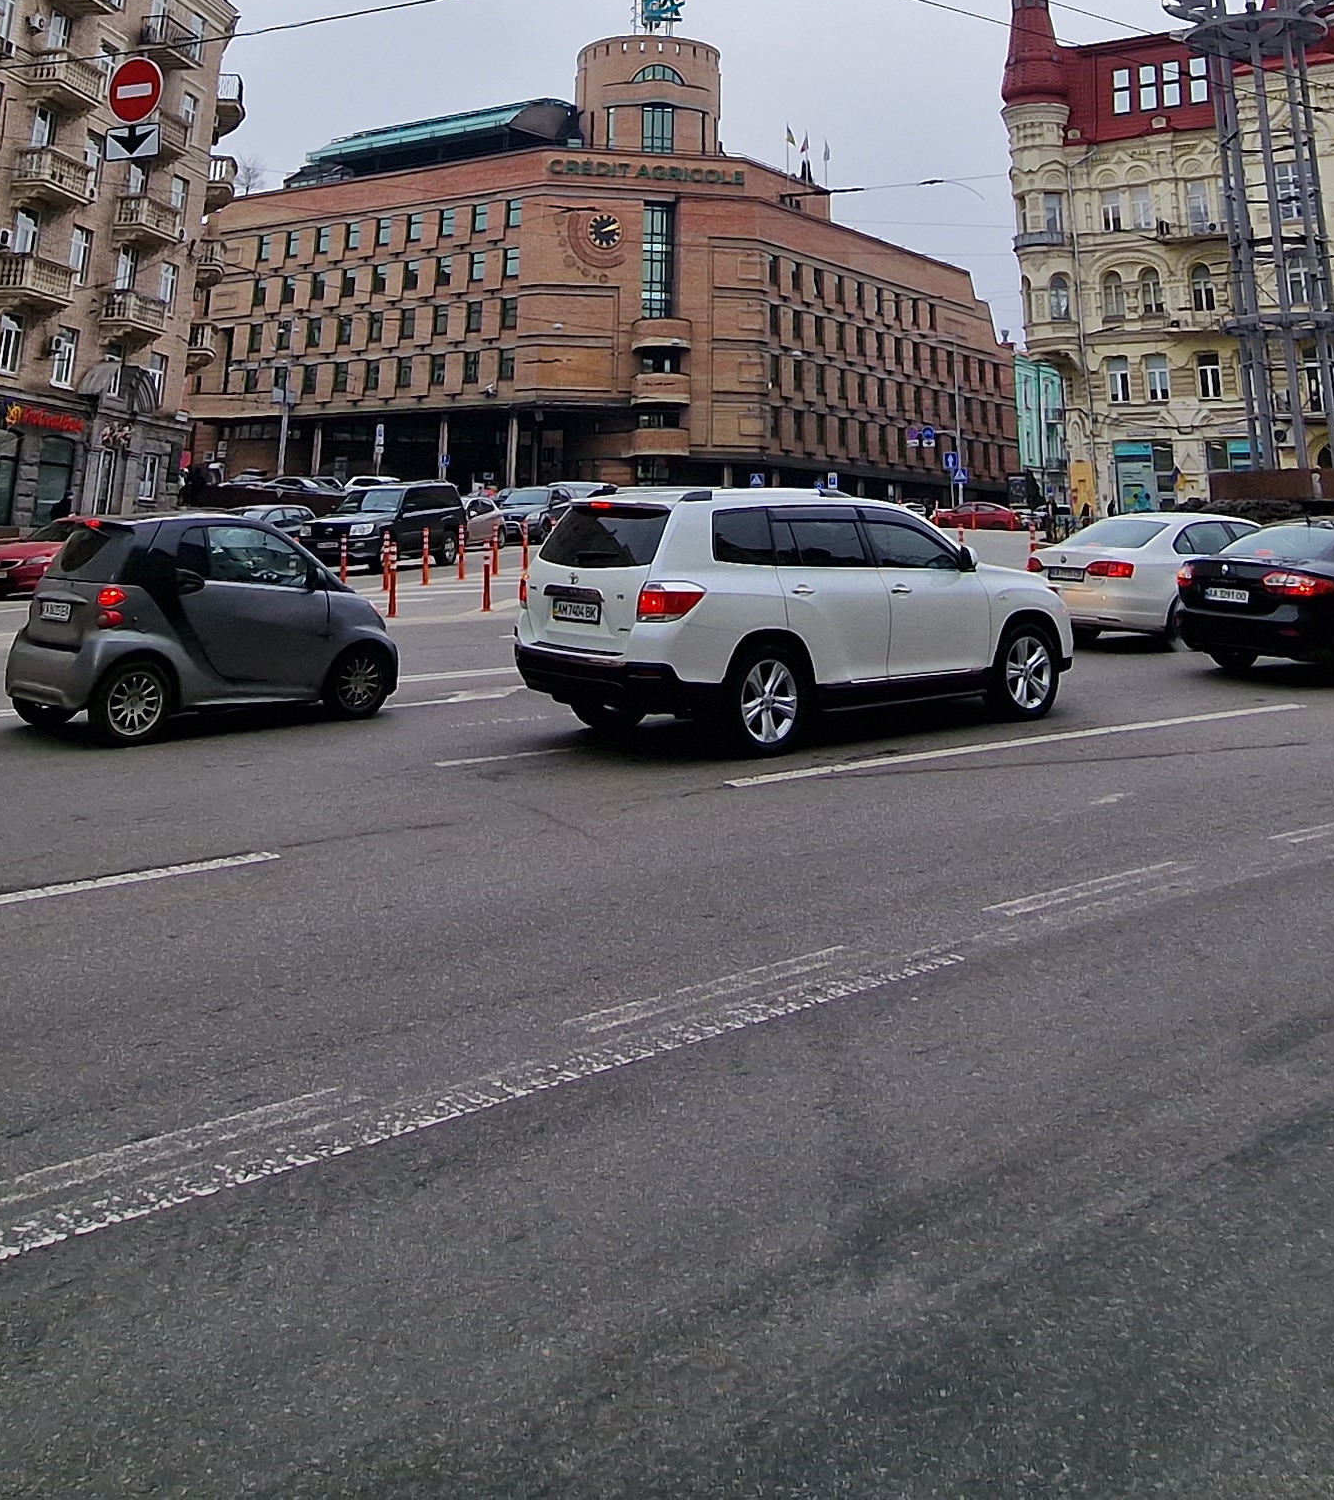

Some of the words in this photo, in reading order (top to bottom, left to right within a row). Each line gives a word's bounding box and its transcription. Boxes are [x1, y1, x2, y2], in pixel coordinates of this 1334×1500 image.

[548, 157, 631, 177] CRÉDIT
[636, 163, 745, 186] AGRICOLE
[557, 603, 568, 616] AM
[568, 604, 585, 618] 7404
[586, 606, 597, 620] BK
